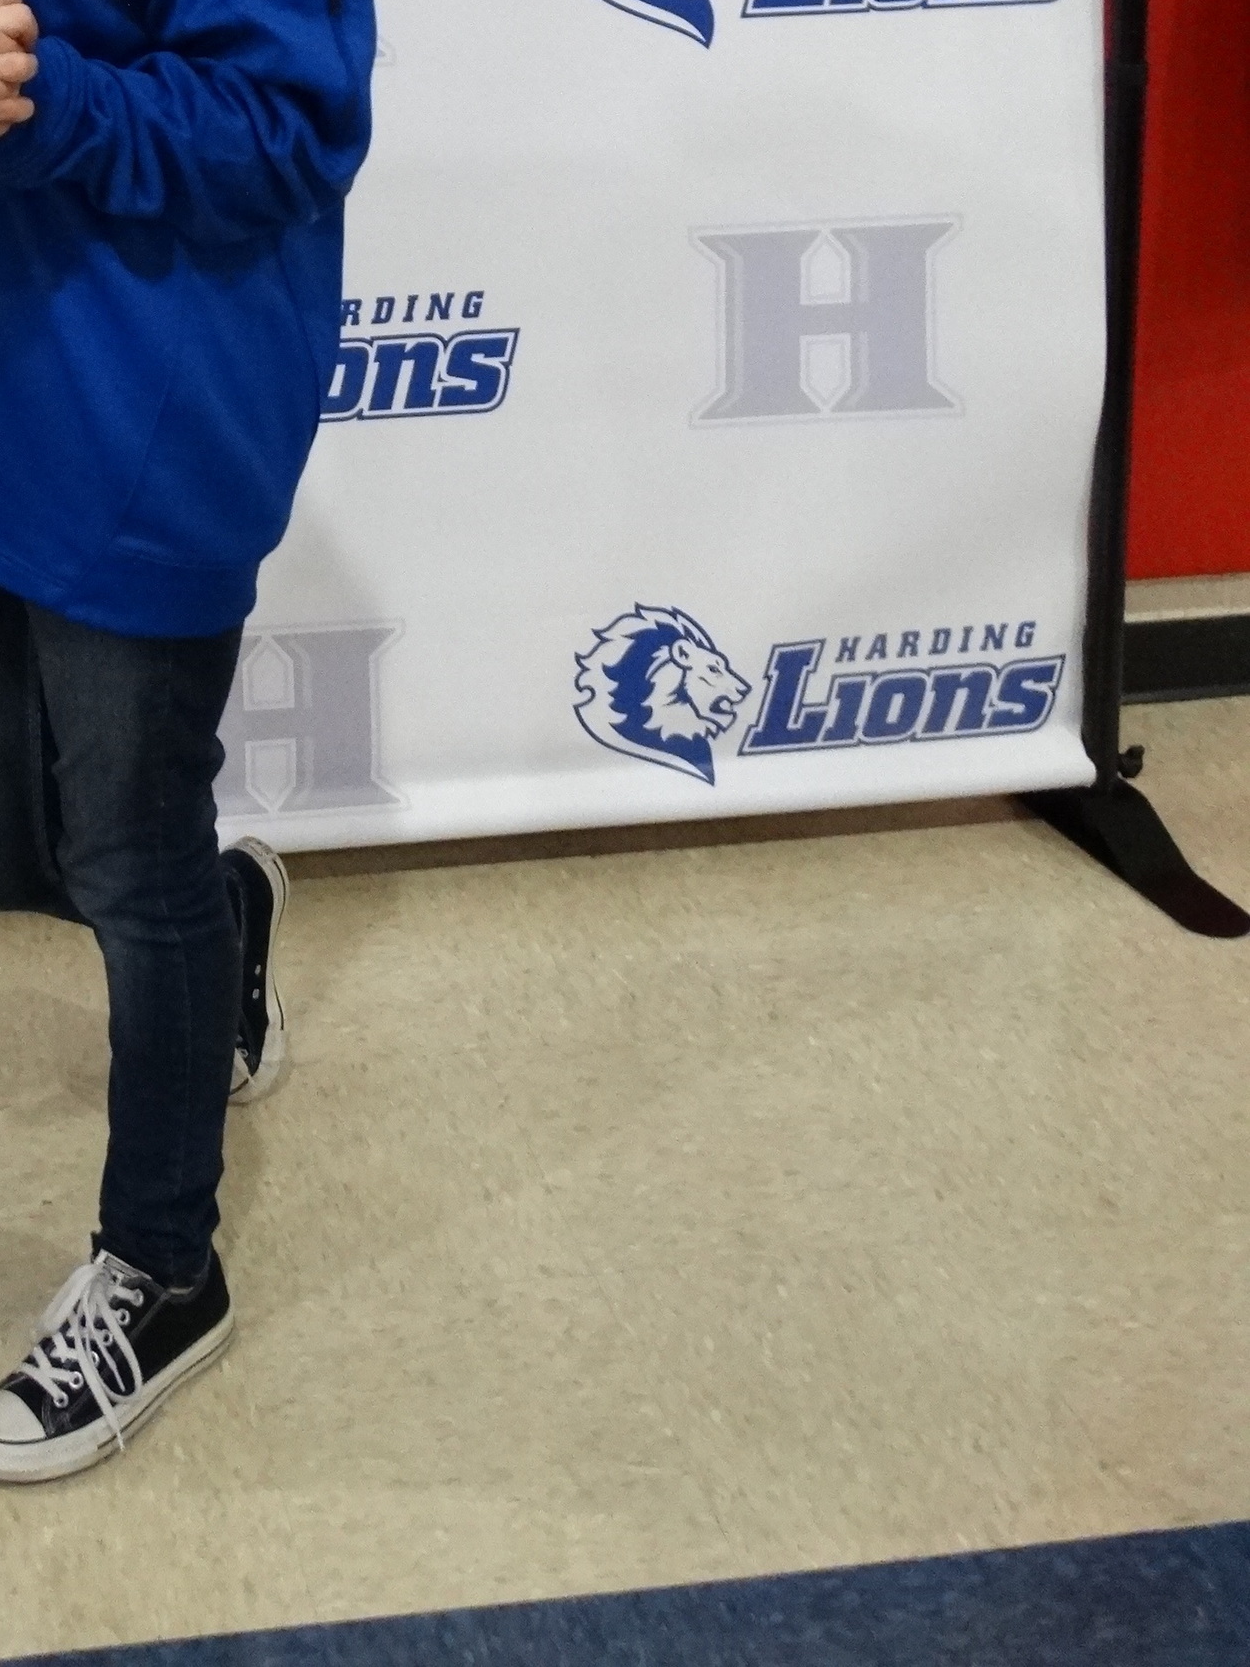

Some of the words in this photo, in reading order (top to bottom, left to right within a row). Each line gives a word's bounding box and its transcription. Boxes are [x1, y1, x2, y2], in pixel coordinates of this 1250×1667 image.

[340, 291, 484, 327] RDING
[688, 213, 963, 429] H
[317, 328, 520, 423] ons
[834, 621, 1037, 663] HARDING
